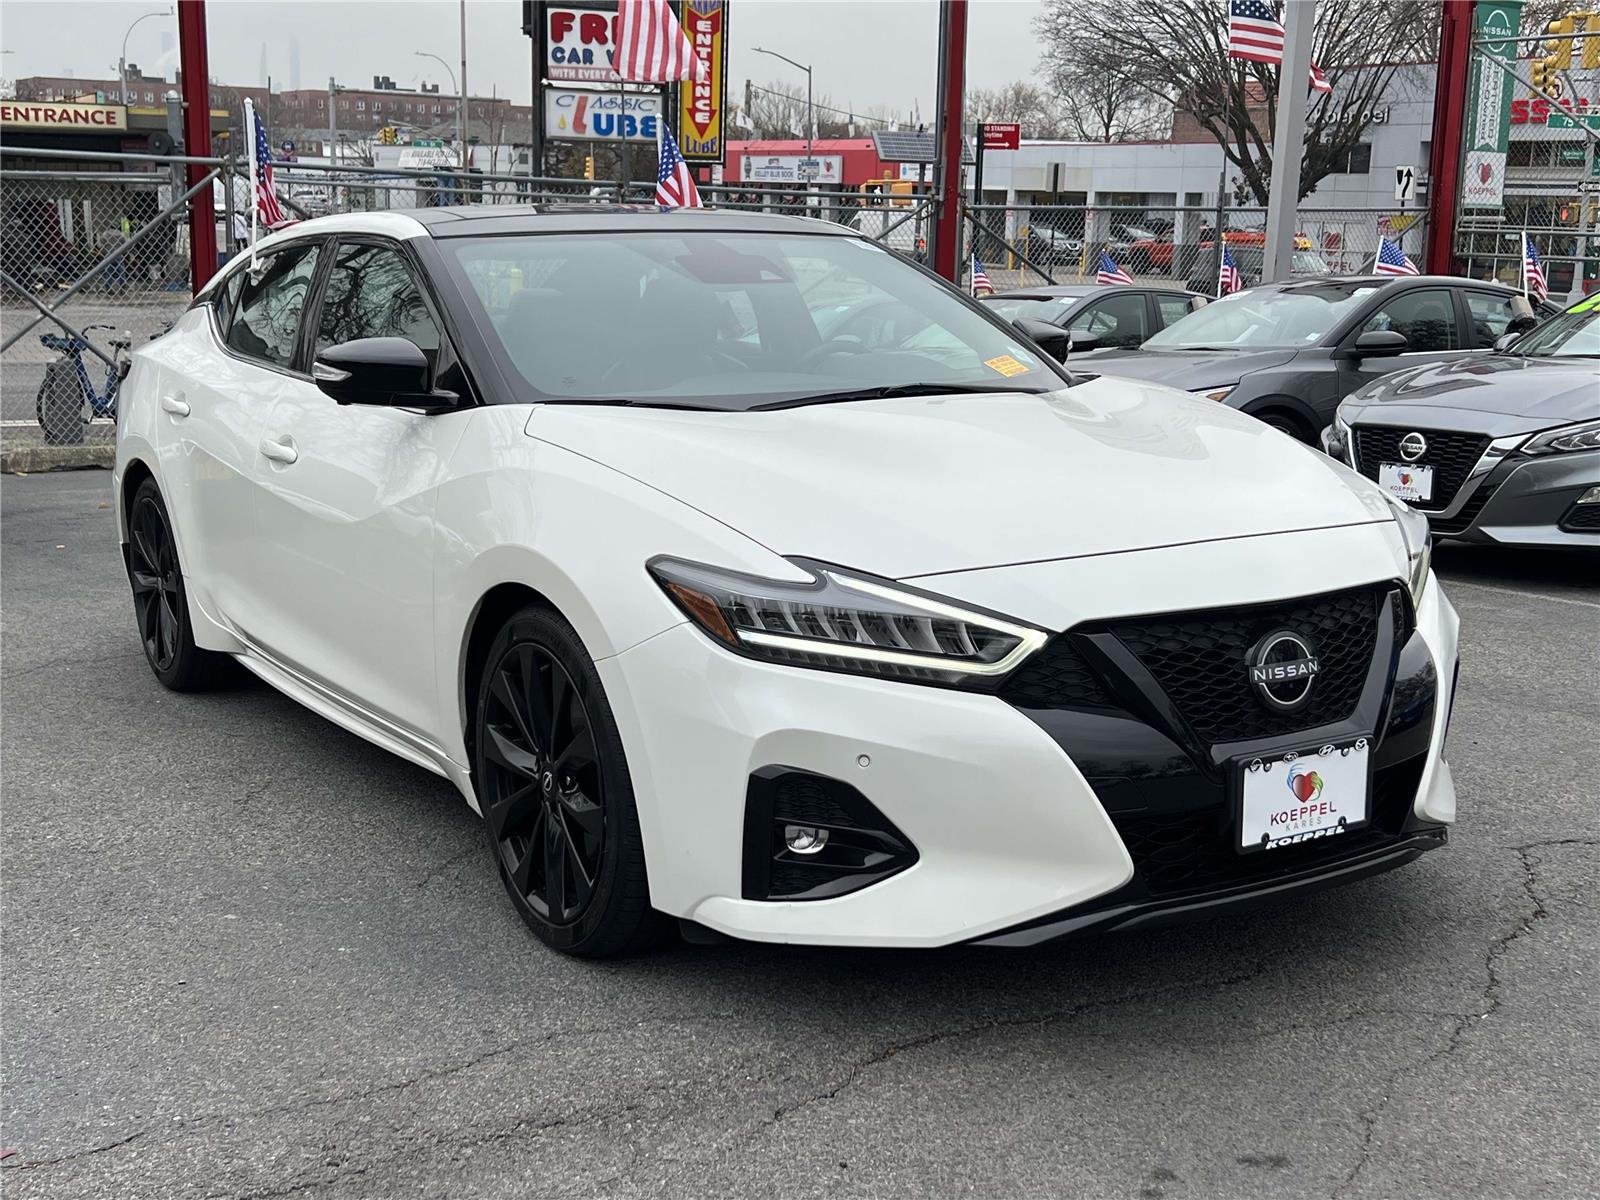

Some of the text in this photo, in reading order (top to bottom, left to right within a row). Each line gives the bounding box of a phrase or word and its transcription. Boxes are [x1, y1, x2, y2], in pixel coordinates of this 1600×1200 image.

[1483, 27, 1512, 36] NISSAN
[551, 46, 594, 65] CAR
[551, 68, 577, 78] WITH
[579, 69, 606, 79] EVERY
[695, 20, 712, 124] ENTRNCE
[0, 106, 117, 125] ENTRANCE
[686, 135, 718, 154] LUBE
[1254, 660, 1318, 681] NISSAN
[1270, 801, 1337, 826] KOEPPEL
[1286, 816, 1322, 832] KARES
[1265, 826, 1345, 849] KOEPPEL
